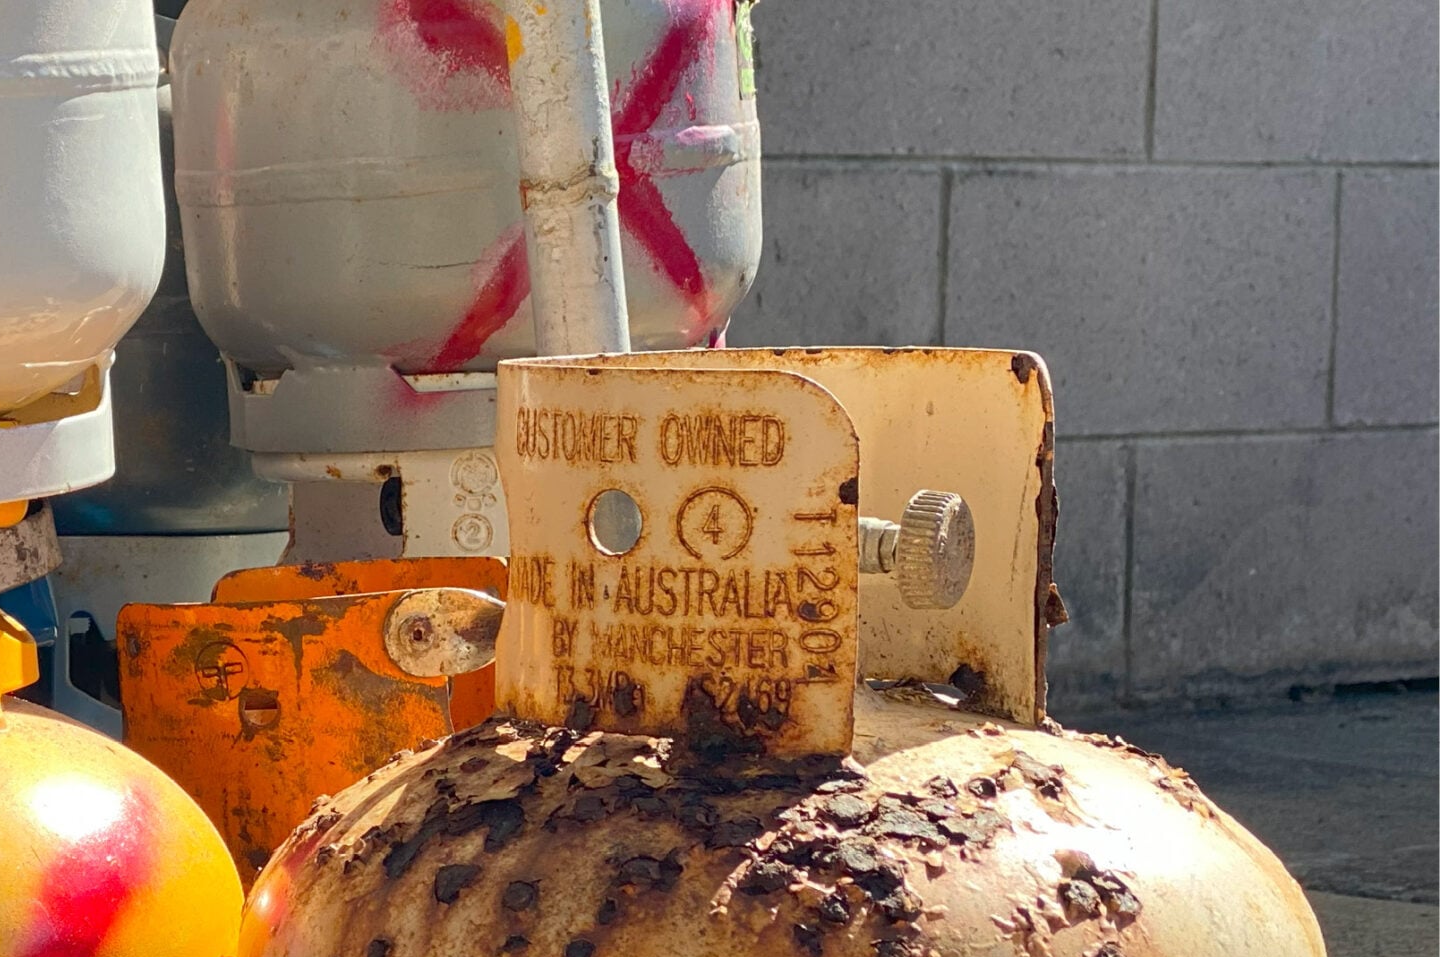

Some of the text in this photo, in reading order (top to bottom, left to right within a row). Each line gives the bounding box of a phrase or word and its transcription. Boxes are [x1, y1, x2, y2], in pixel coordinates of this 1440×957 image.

[516, 406, 786, 468] CUSTOMER OWNED
[702, 503, 724, 546] 4
[570, 562, 596, 611] IN
[613, 565, 796, 620] AUSTRALIA
[553, 617, 790, 669] BY MANCHESTER
